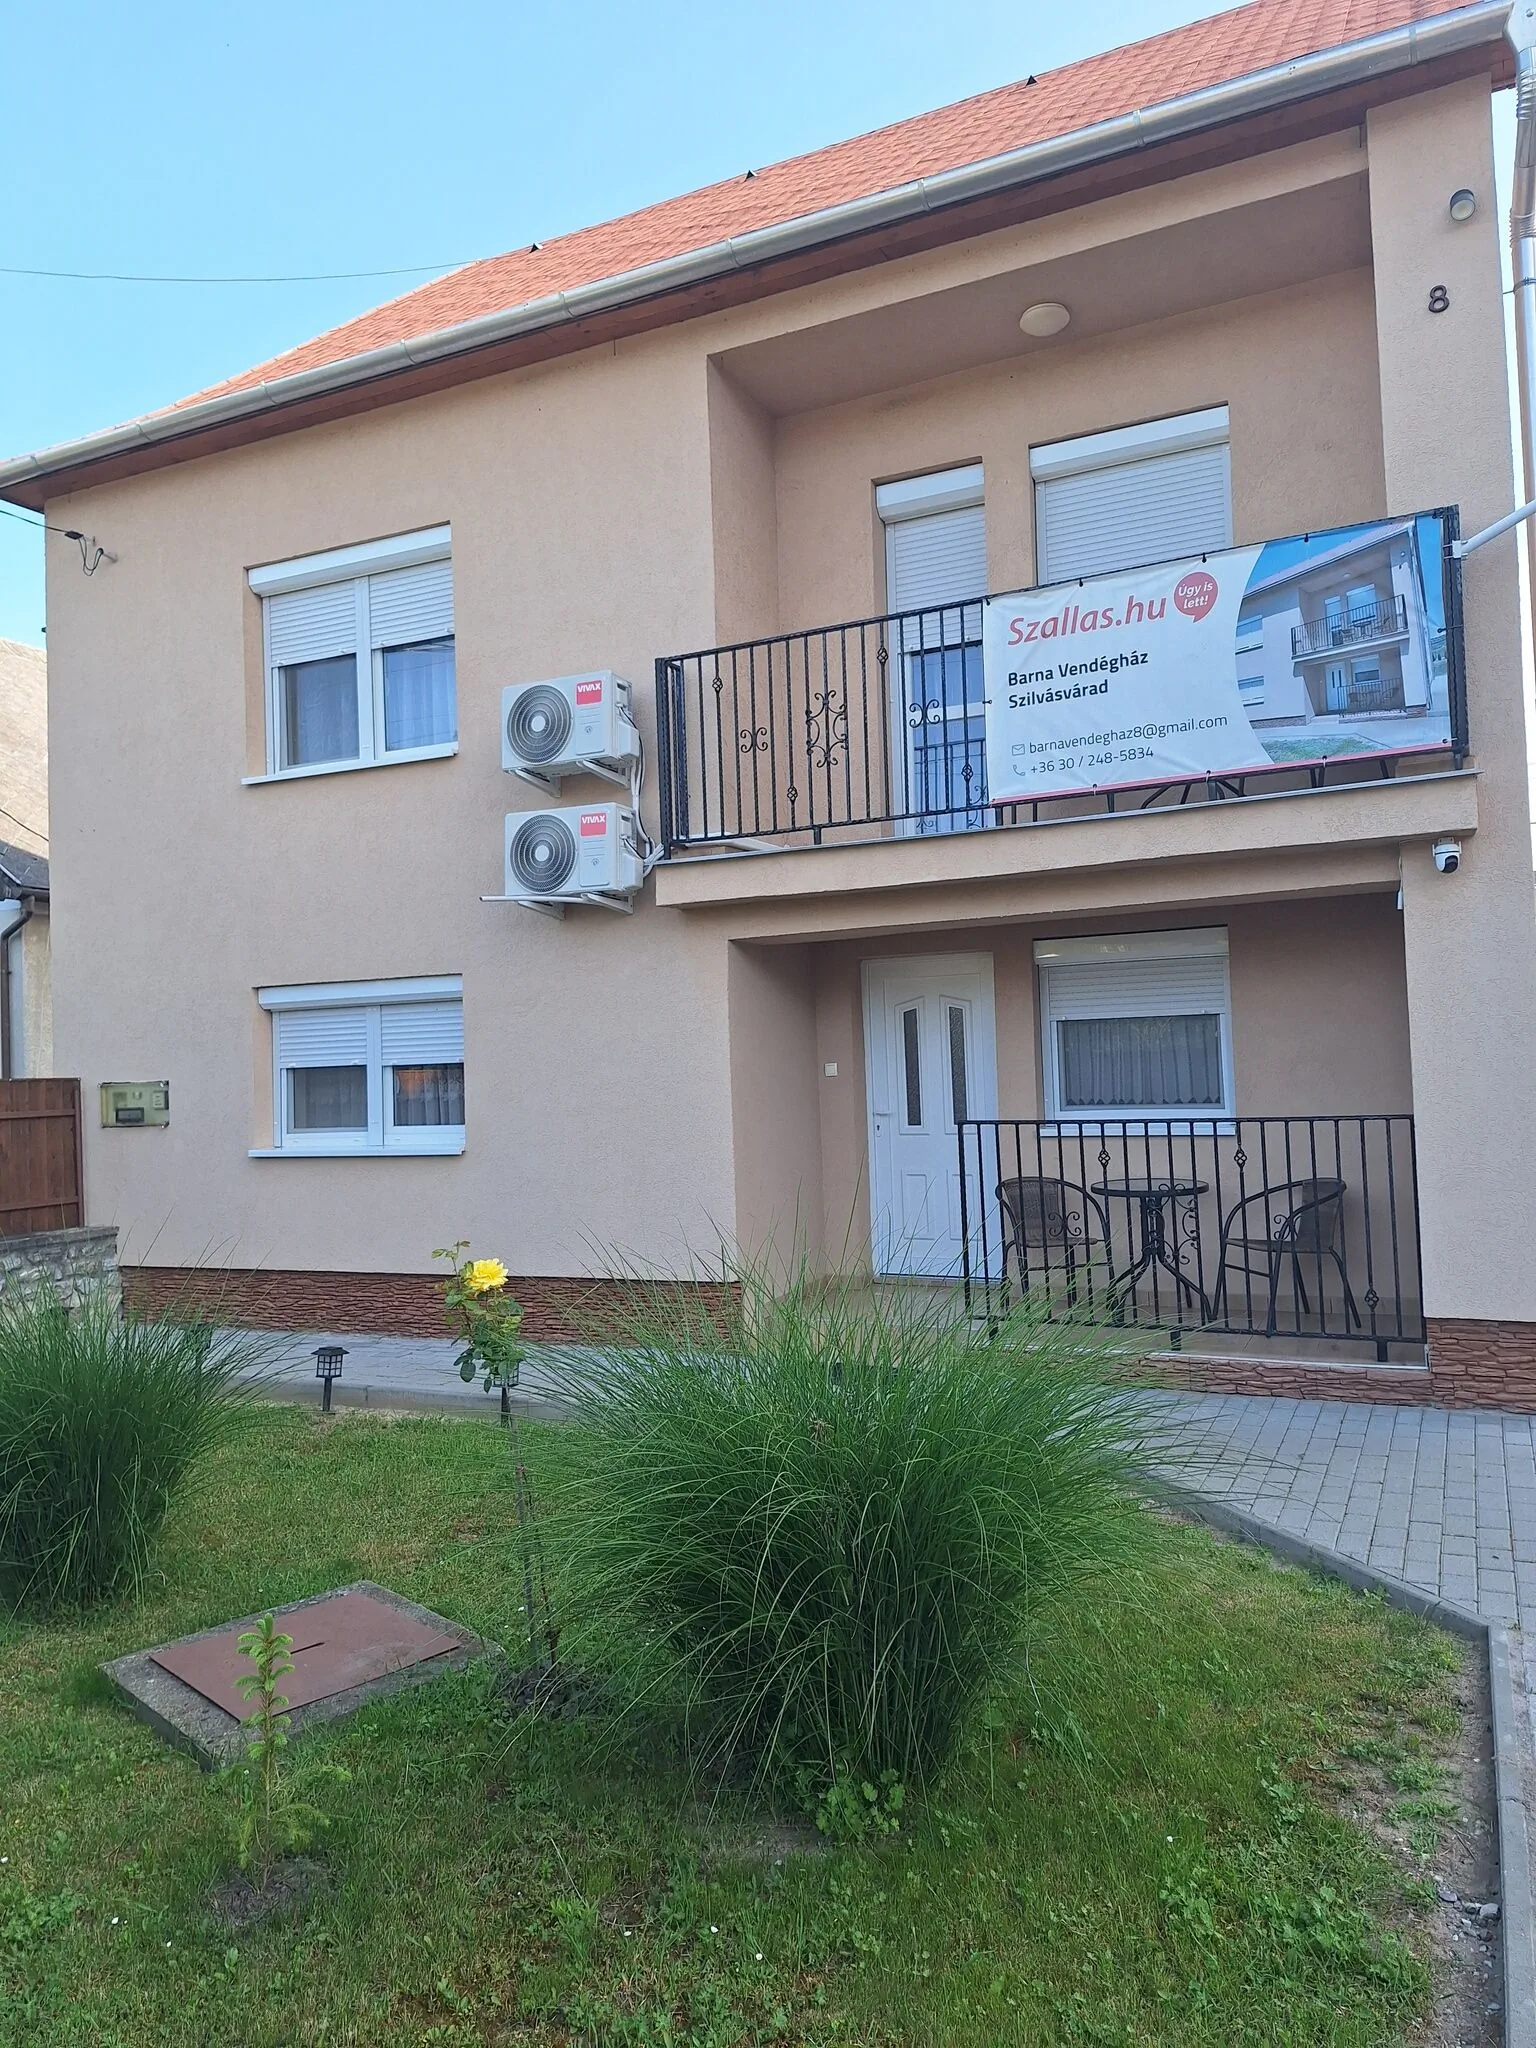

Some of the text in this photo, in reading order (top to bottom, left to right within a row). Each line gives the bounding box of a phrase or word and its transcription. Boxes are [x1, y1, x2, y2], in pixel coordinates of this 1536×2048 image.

[1428, 284, 1450, 313] 8
[1178, 581, 1214, 598] Úgy is
[1183, 594, 1209, 609] lett!
[1007, 595, 1168, 646] Szallas.hu
[1008, 650, 1149, 687] Barna Vendégház
[577, 682, 602, 693] VIVAX
[1009, 679, 1109, 709] Szilvásvárad
[1028, 715, 1229, 754] barnavendeghaz8@gmail.com
[1030, 746, 1154, 774] +36 30 / 248-5834
[581, 814, 606, 824] VIVAX
